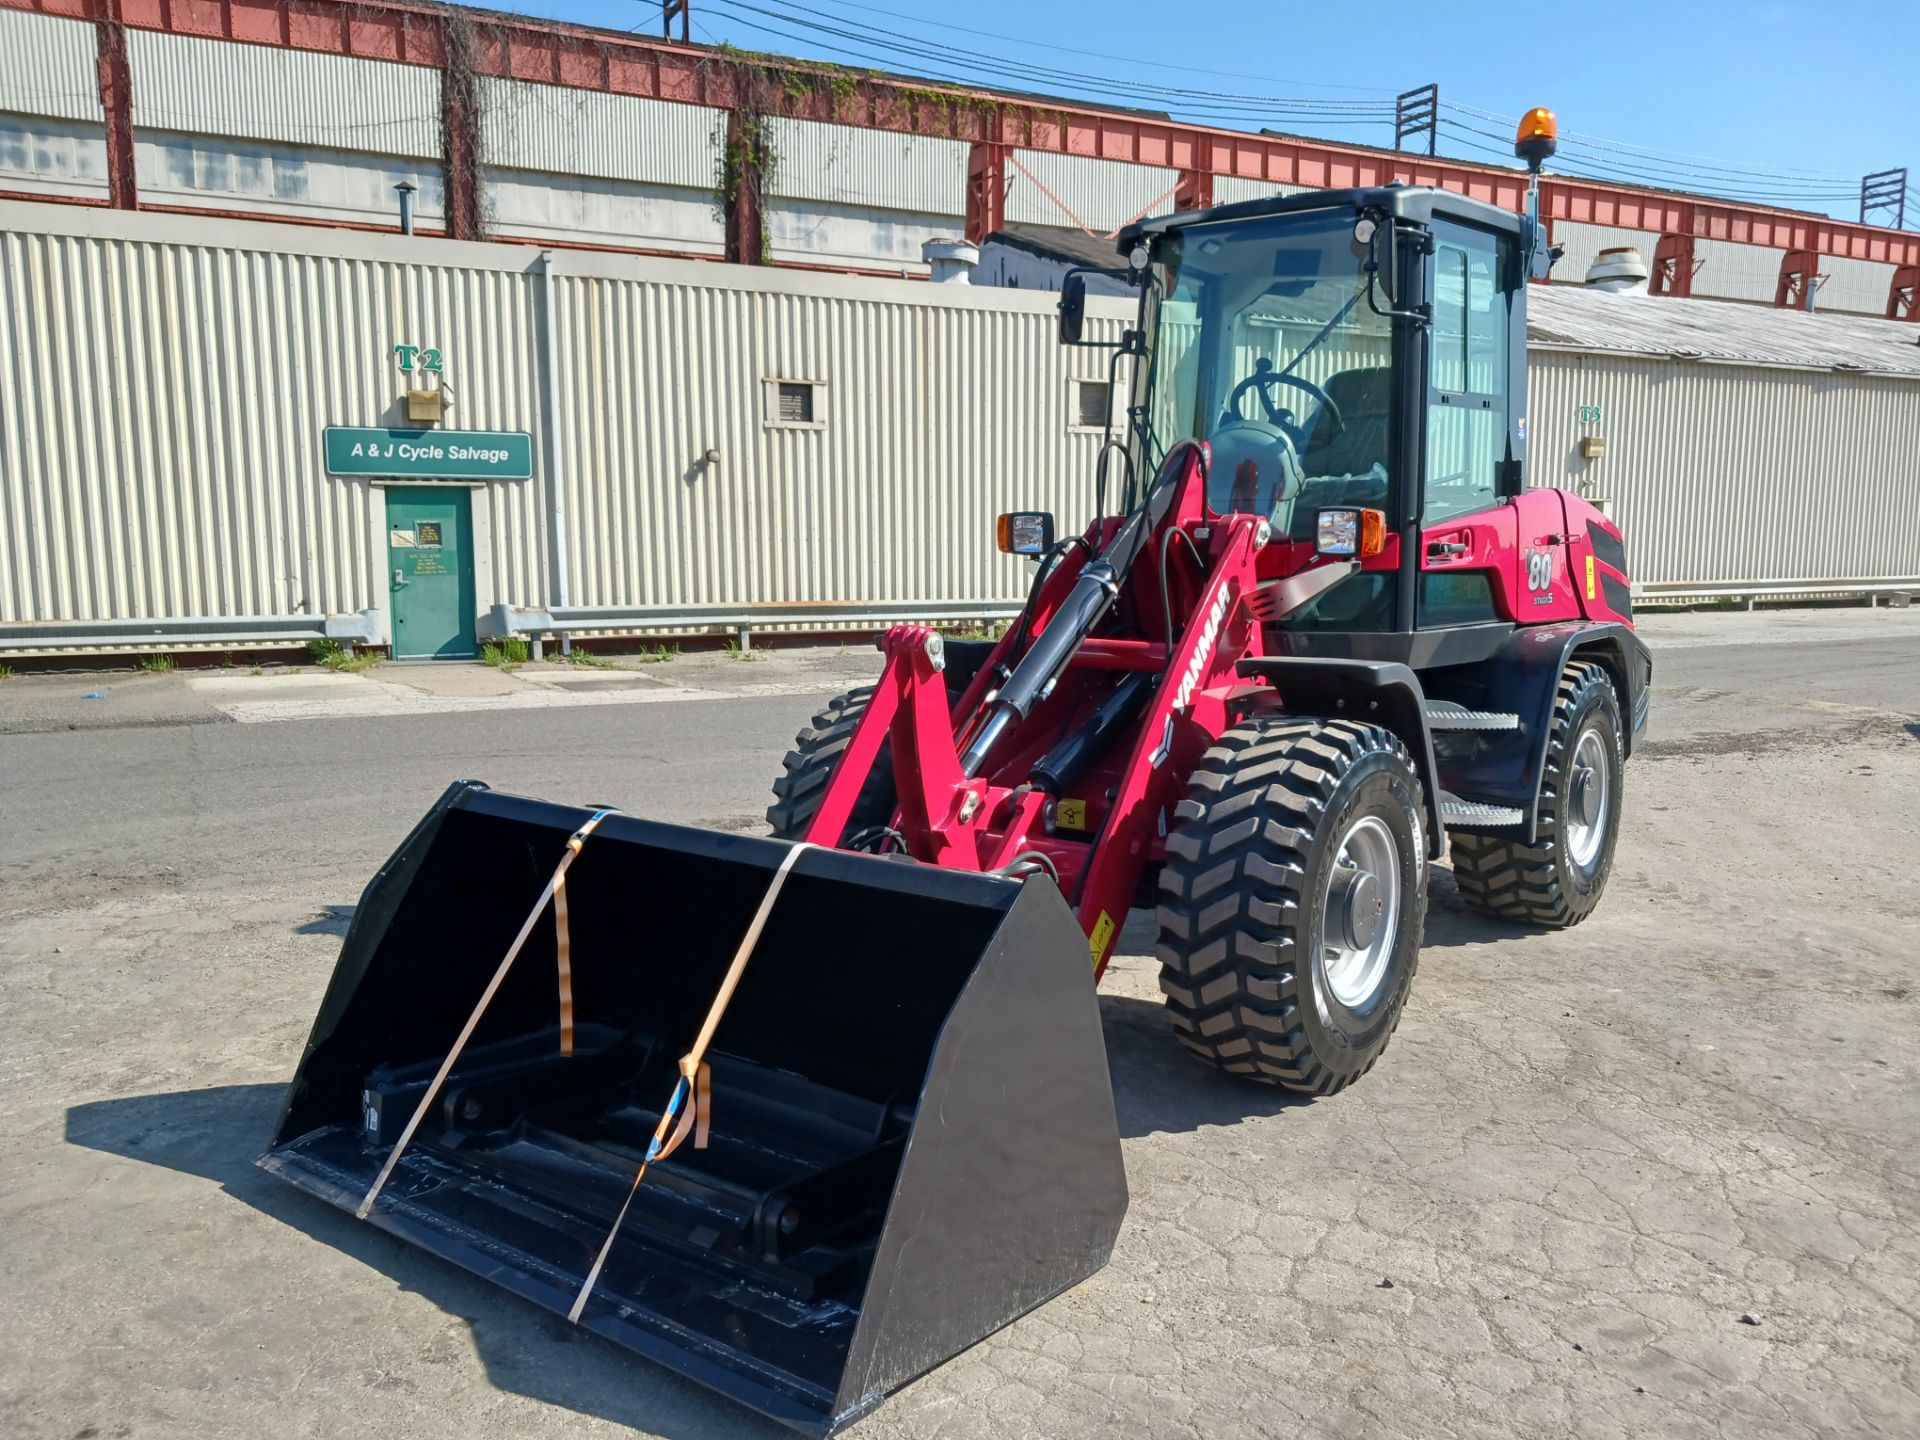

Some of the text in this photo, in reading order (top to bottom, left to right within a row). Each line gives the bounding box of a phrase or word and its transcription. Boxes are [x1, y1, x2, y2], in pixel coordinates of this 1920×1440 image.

[394, 344, 444, 373] T2
[1580, 405, 1601, 423] T3
[351, 443, 509, 464] A & J Cycle Salvage
[1172, 580, 1231, 716] YANMAR
